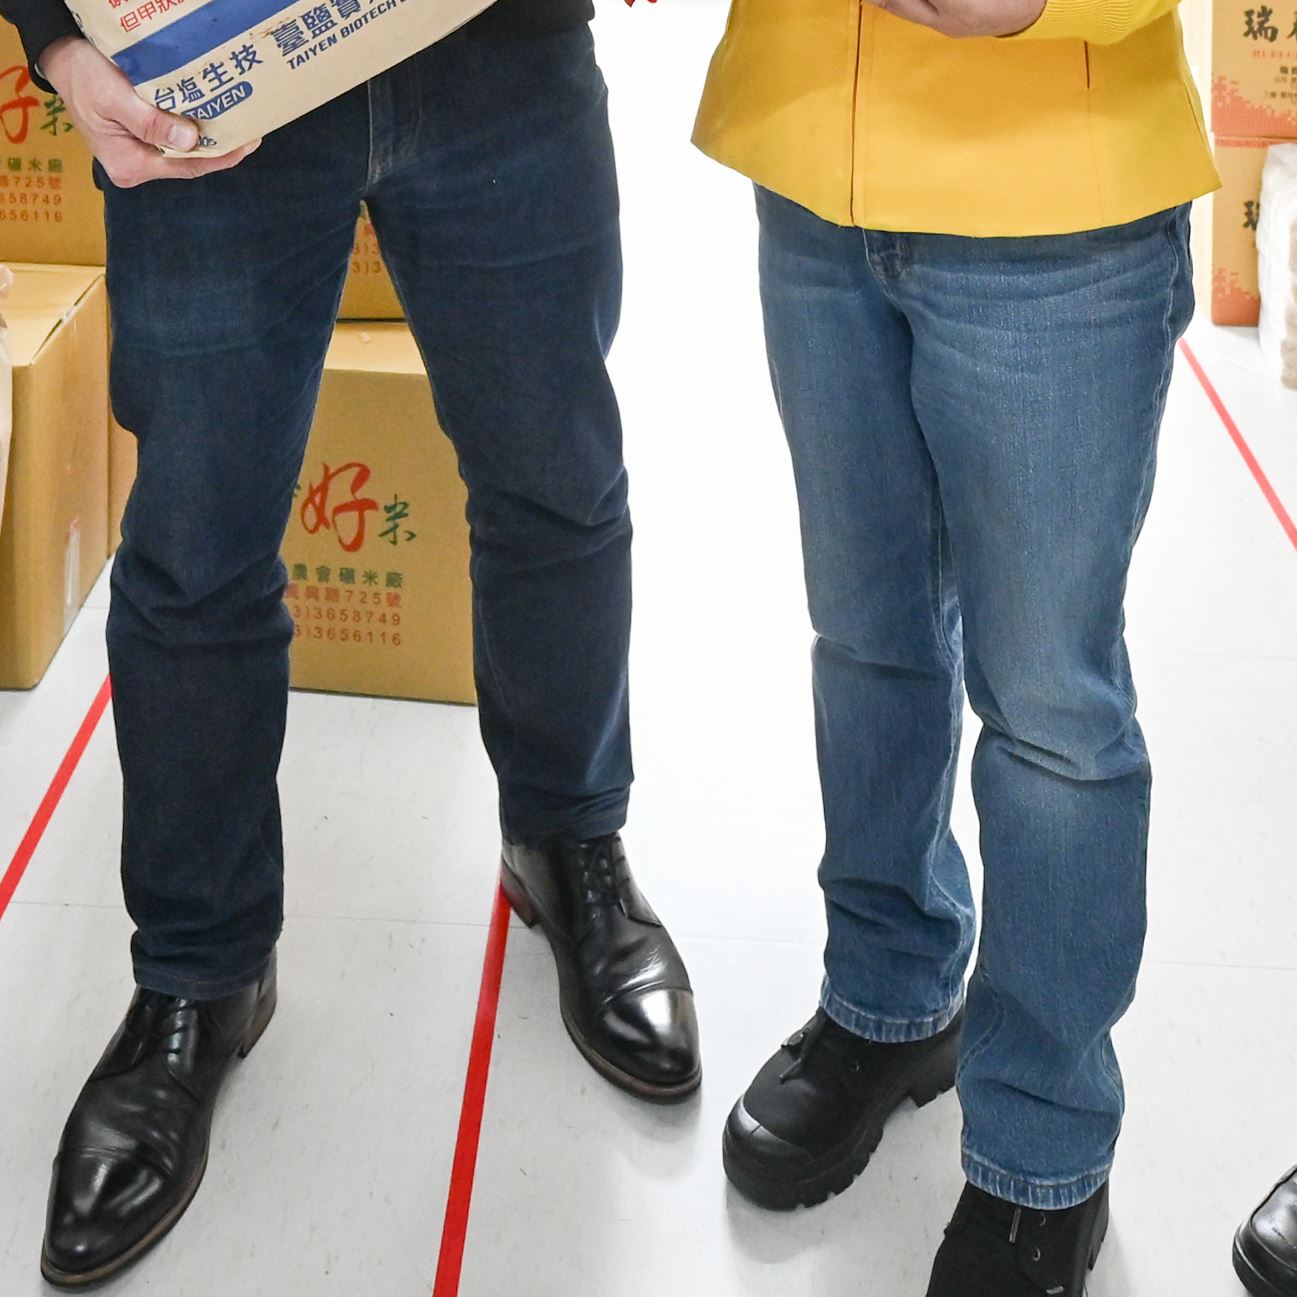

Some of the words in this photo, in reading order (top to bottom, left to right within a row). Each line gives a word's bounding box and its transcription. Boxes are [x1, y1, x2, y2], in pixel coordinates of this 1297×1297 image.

[286, 32, 338, 70] TAIYEN
[340, 0, 399, 38] BIOTECH
[186, 85, 246, 120] TAIYEN
